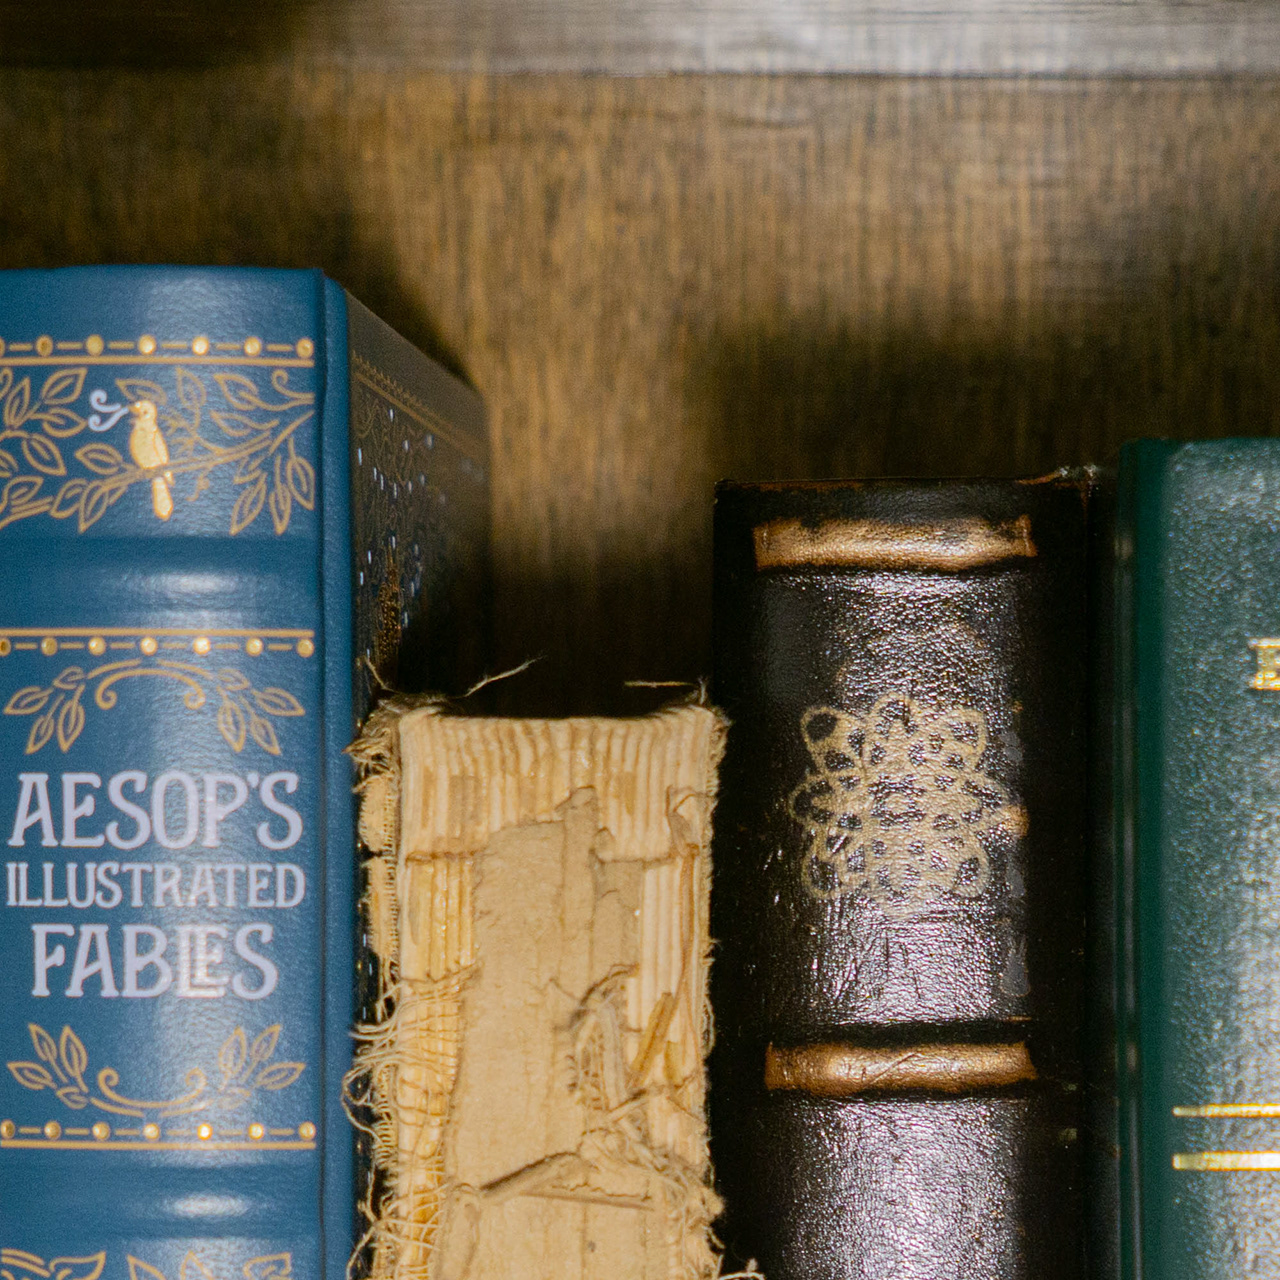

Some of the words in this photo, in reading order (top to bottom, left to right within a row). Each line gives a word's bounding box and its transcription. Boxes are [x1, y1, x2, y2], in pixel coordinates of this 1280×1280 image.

[7, 769, 304, 851] AESOP'S
[5, 861, 307, 909] ILLUSTRATED
[31, 921, 280, 1001] FABLES
